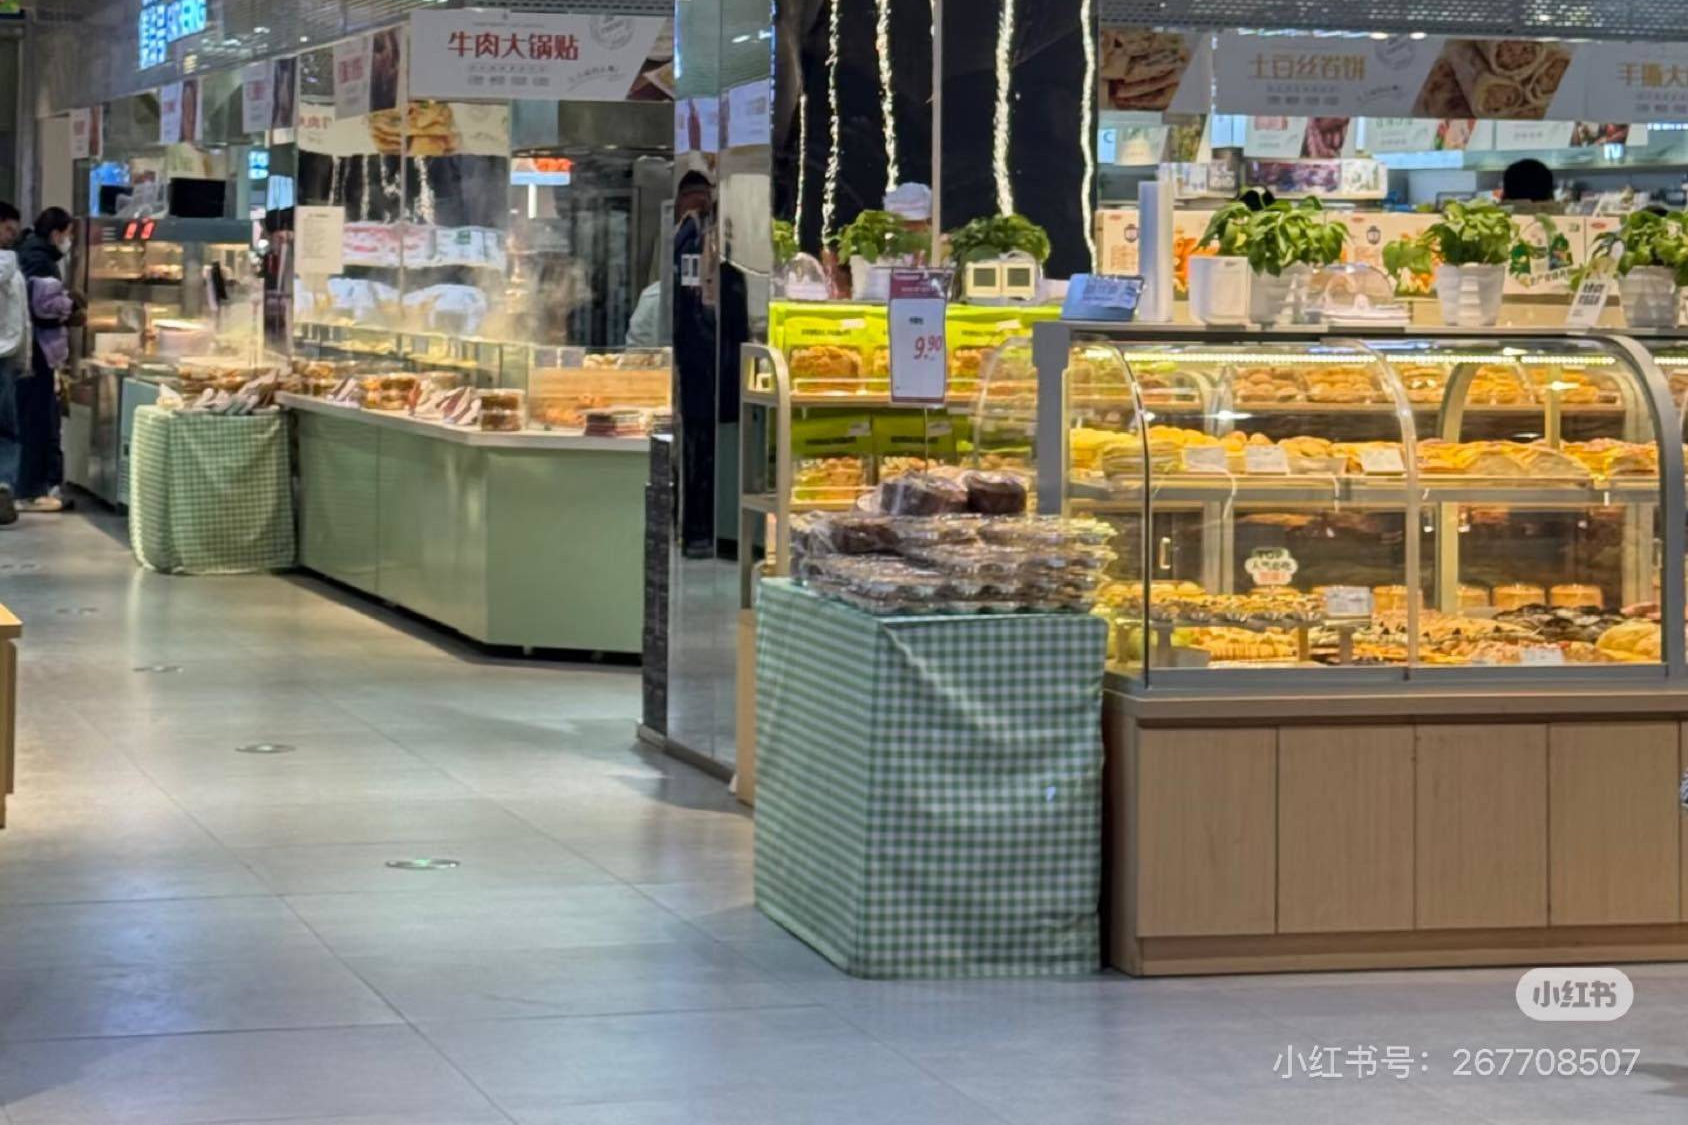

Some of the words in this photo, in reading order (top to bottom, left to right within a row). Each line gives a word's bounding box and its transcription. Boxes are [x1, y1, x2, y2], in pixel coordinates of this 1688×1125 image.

[448, 30, 581, 61] 牛肉大锅贴
[913, 335, 942, 360] 9.90
